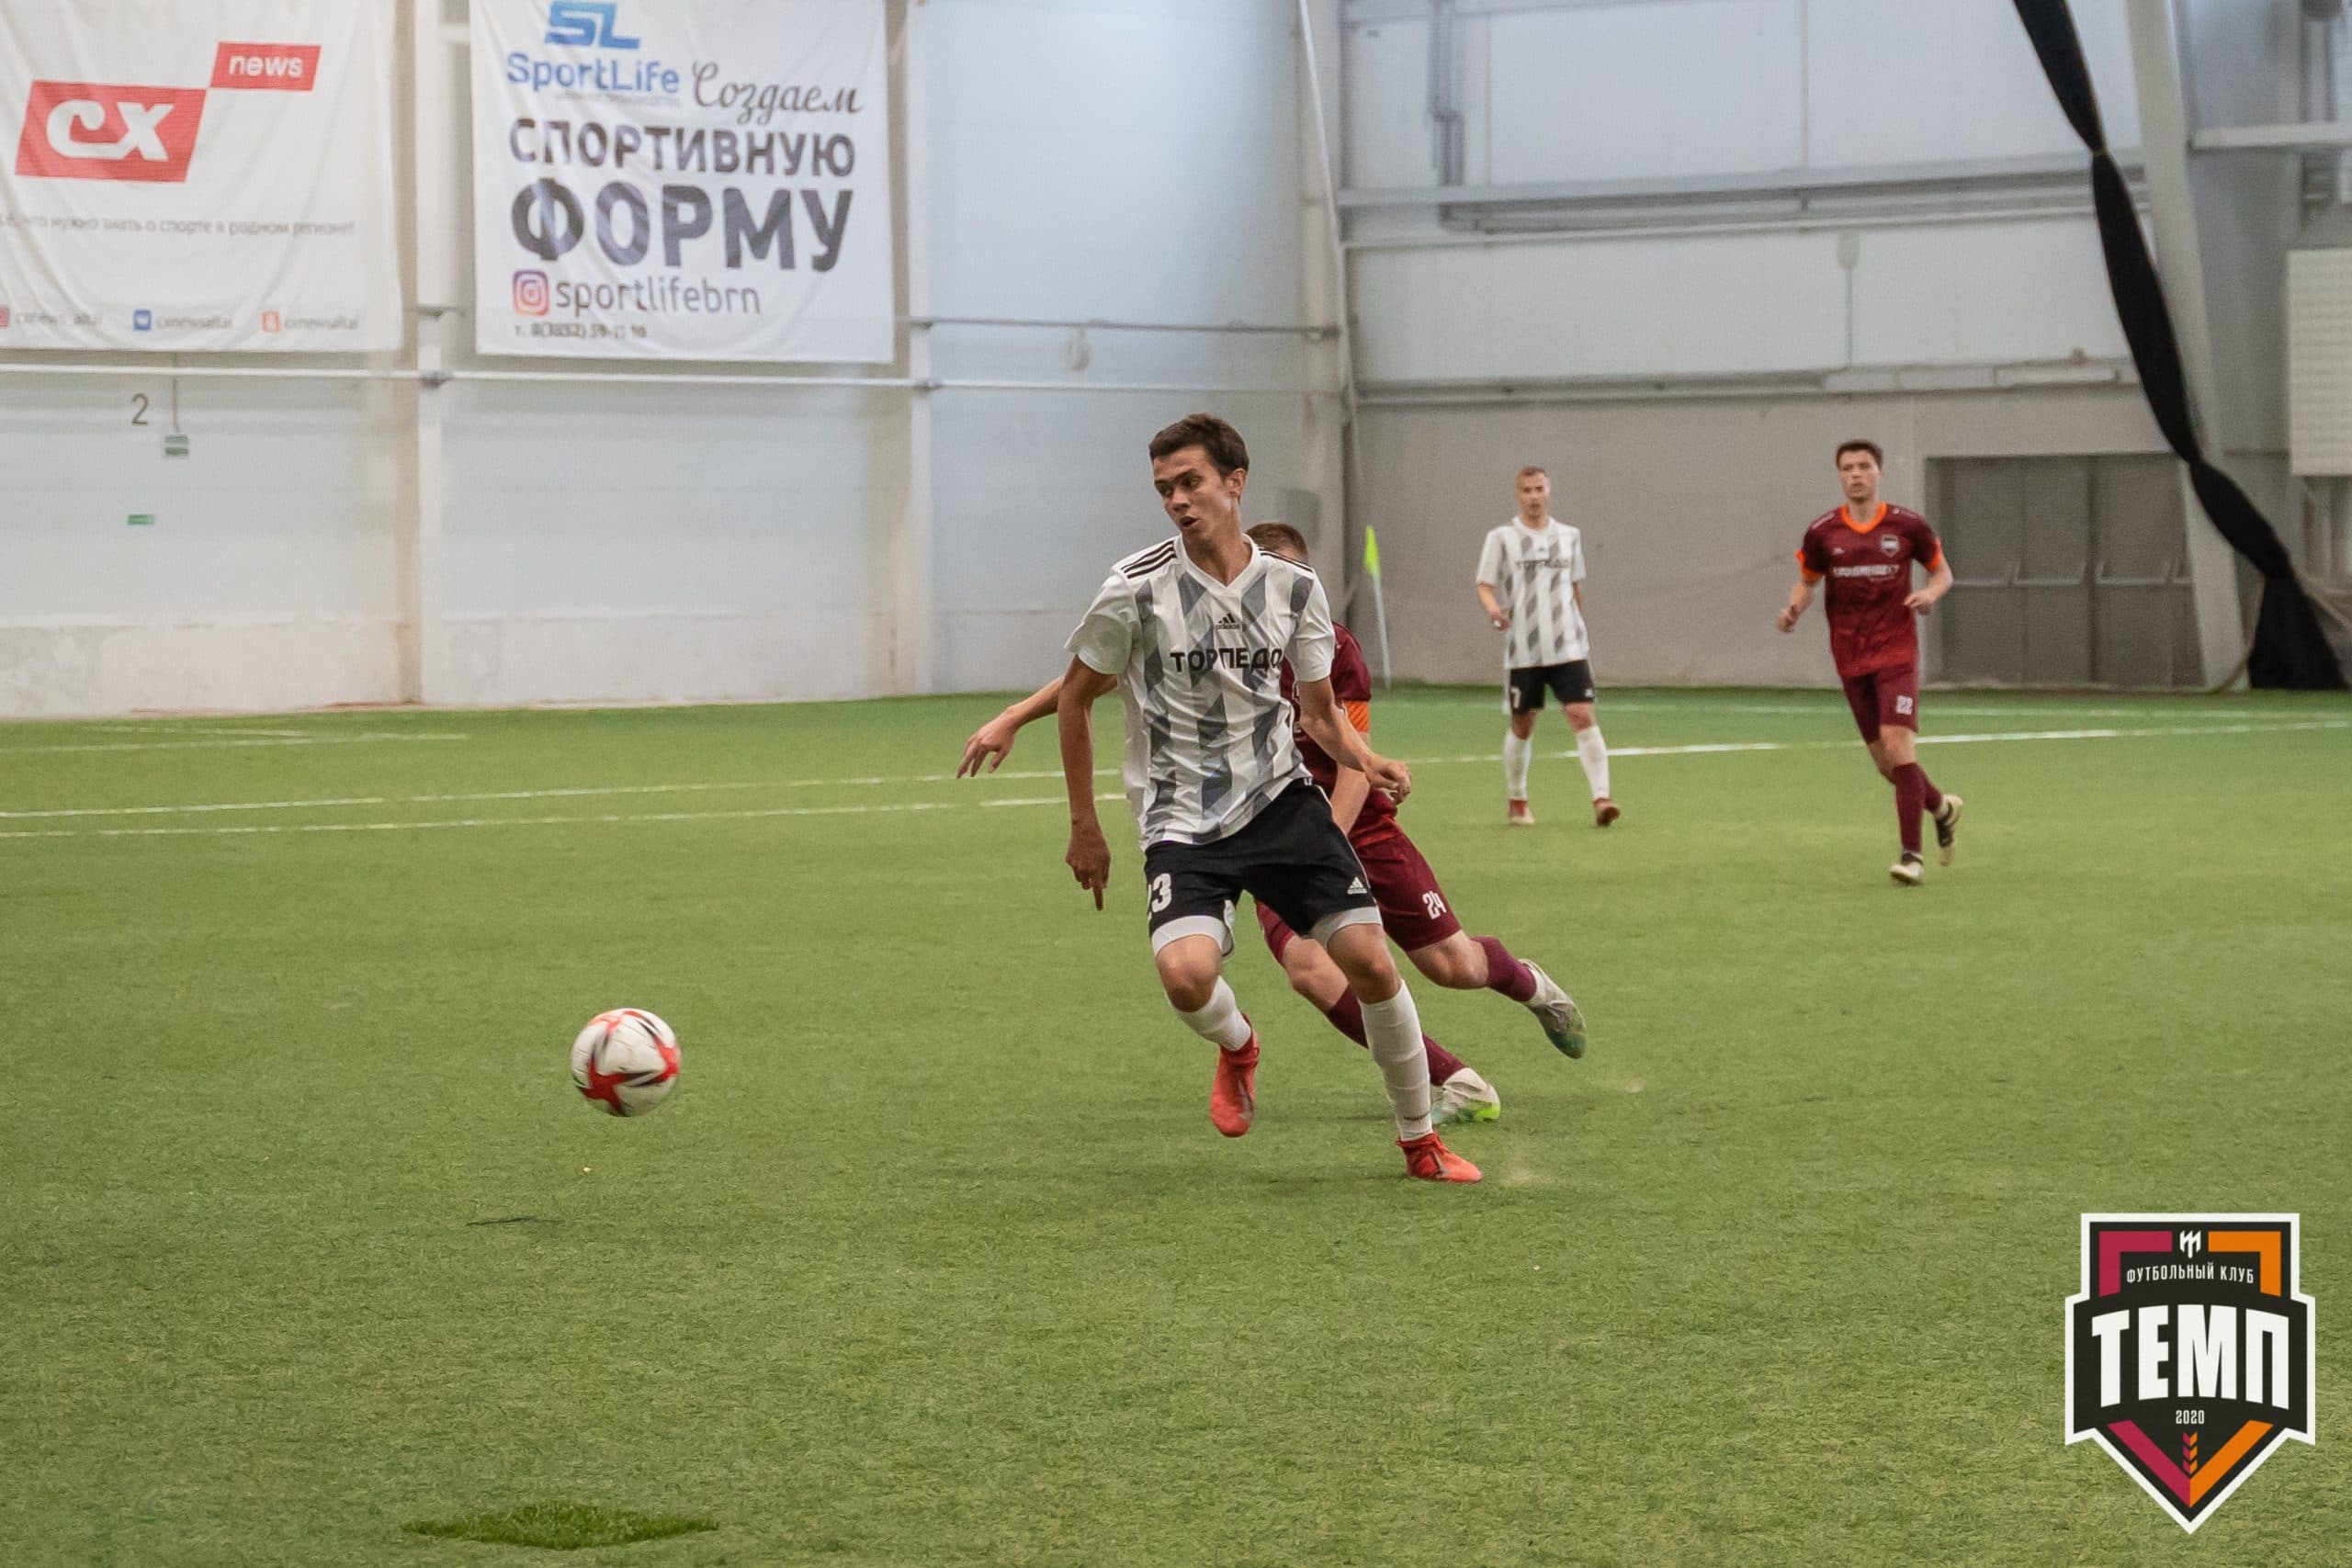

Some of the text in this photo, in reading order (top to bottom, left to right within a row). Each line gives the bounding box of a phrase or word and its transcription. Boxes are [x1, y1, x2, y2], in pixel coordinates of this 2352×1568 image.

[228, 52, 304, 78] news
[507, 51, 680, 94] SportLife
[692, 61, 863, 125] Создаем
[509, 118, 855, 177] СПОРТИВНУЮ
[512, 176, 854, 272] ФОРМУ
[555, 275, 762, 318] sportlifebrn
[131, 392, 149, 426] 2
[1170, 647, 1283, 673] ТОРПЕДО
[1421, 890, 1447, 919] 24
